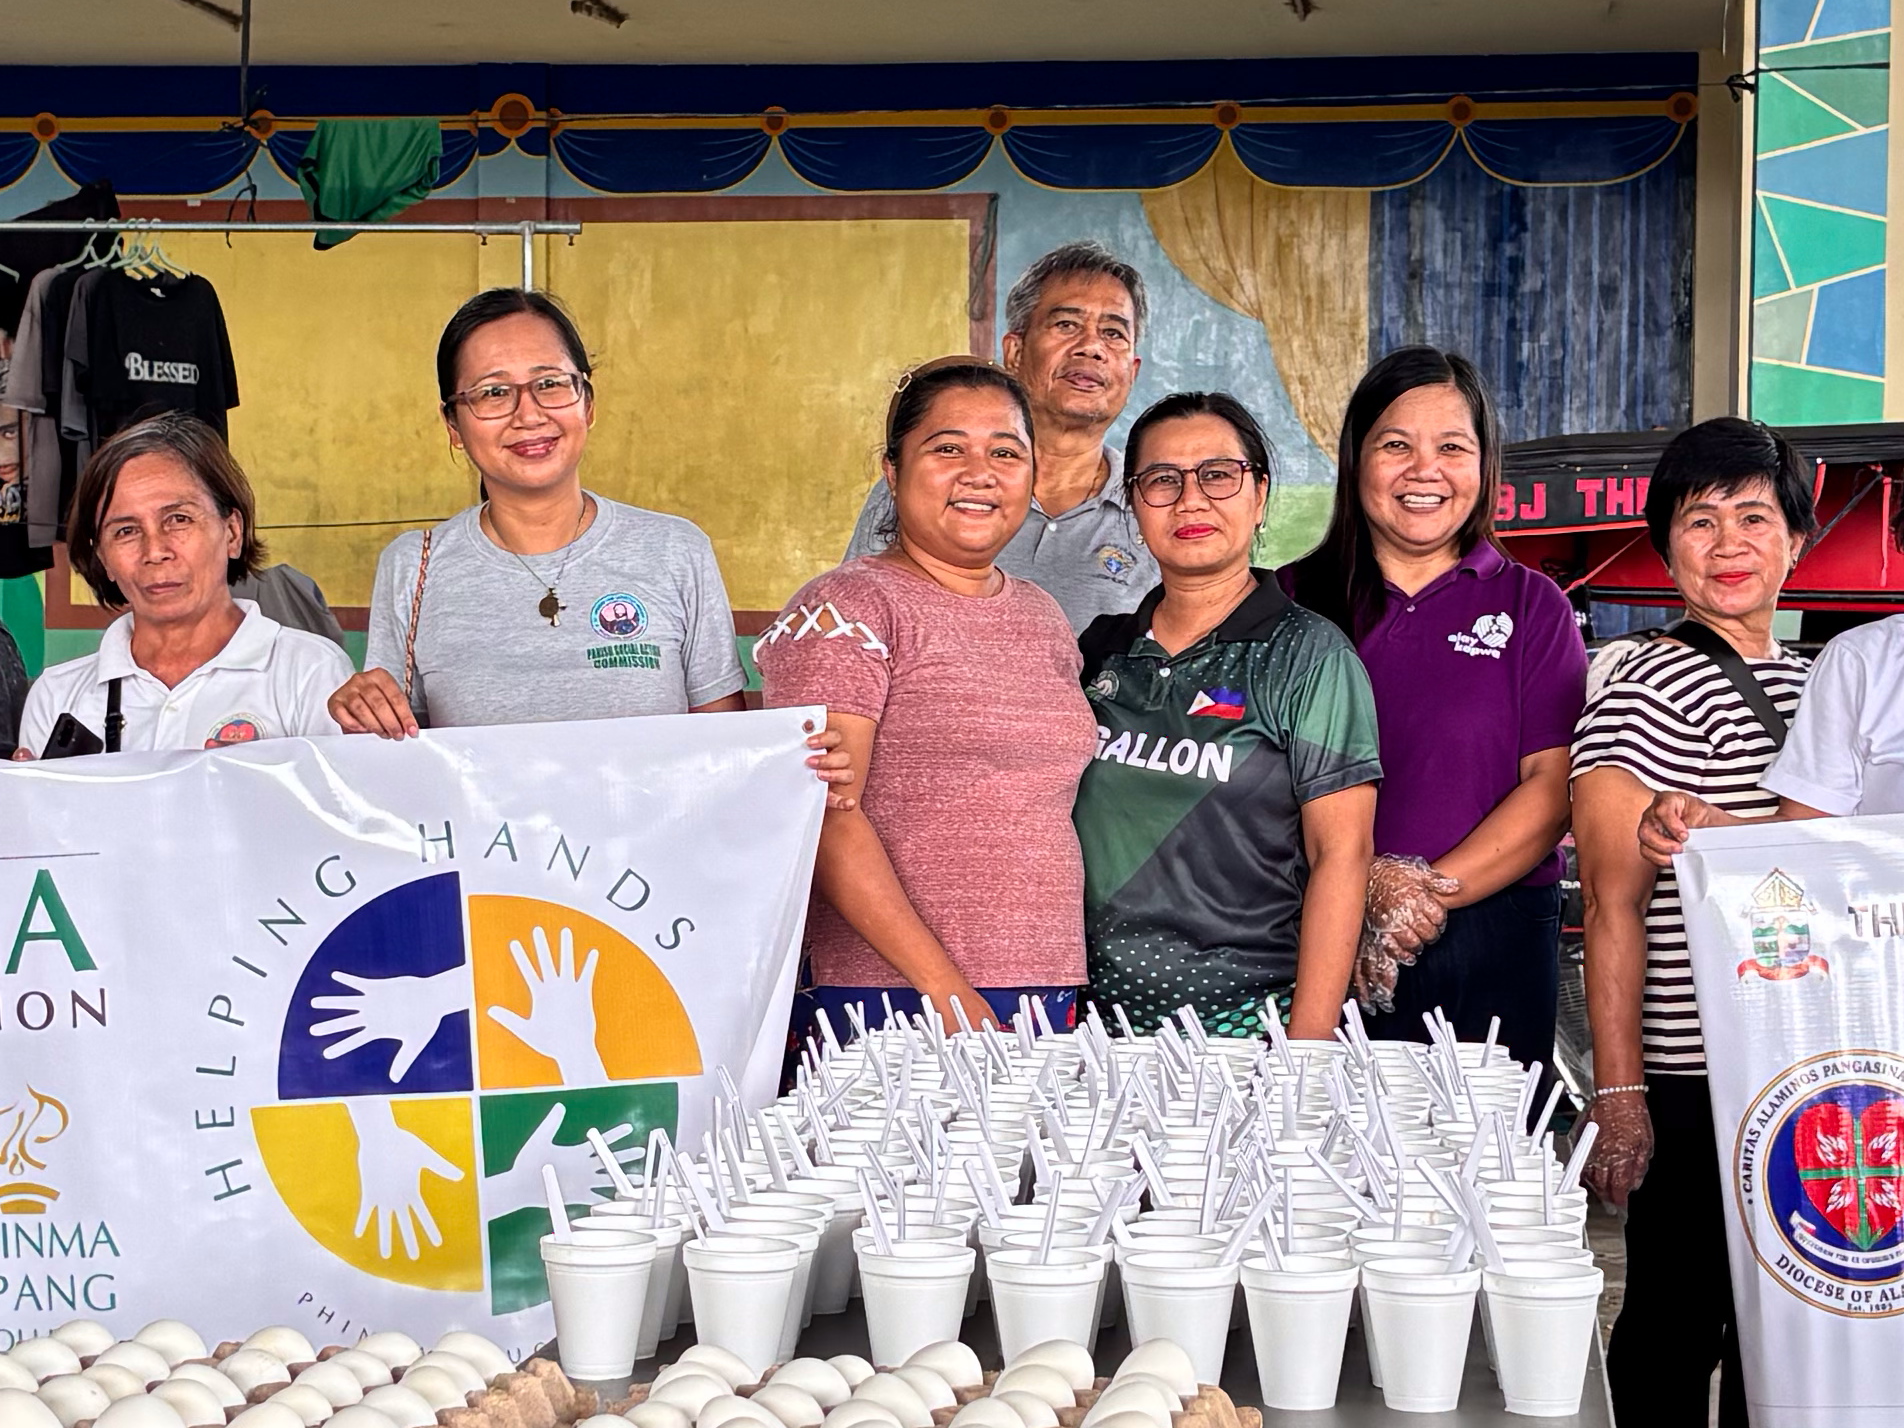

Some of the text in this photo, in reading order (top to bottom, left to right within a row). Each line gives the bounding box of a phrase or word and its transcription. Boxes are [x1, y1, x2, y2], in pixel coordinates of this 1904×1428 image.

[1454, 641, 1501, 659] kapwa
[195, 820, 696, 1202] HELPING HANDS
[1742, 1128, 1761, 1193] CARITAS
[1759, 1069, 1819, 1128] ALAMINOS
[1775, 1253, 1845, 1301] DIOCESE
[1851, 1289, 1873, 1303] OF
